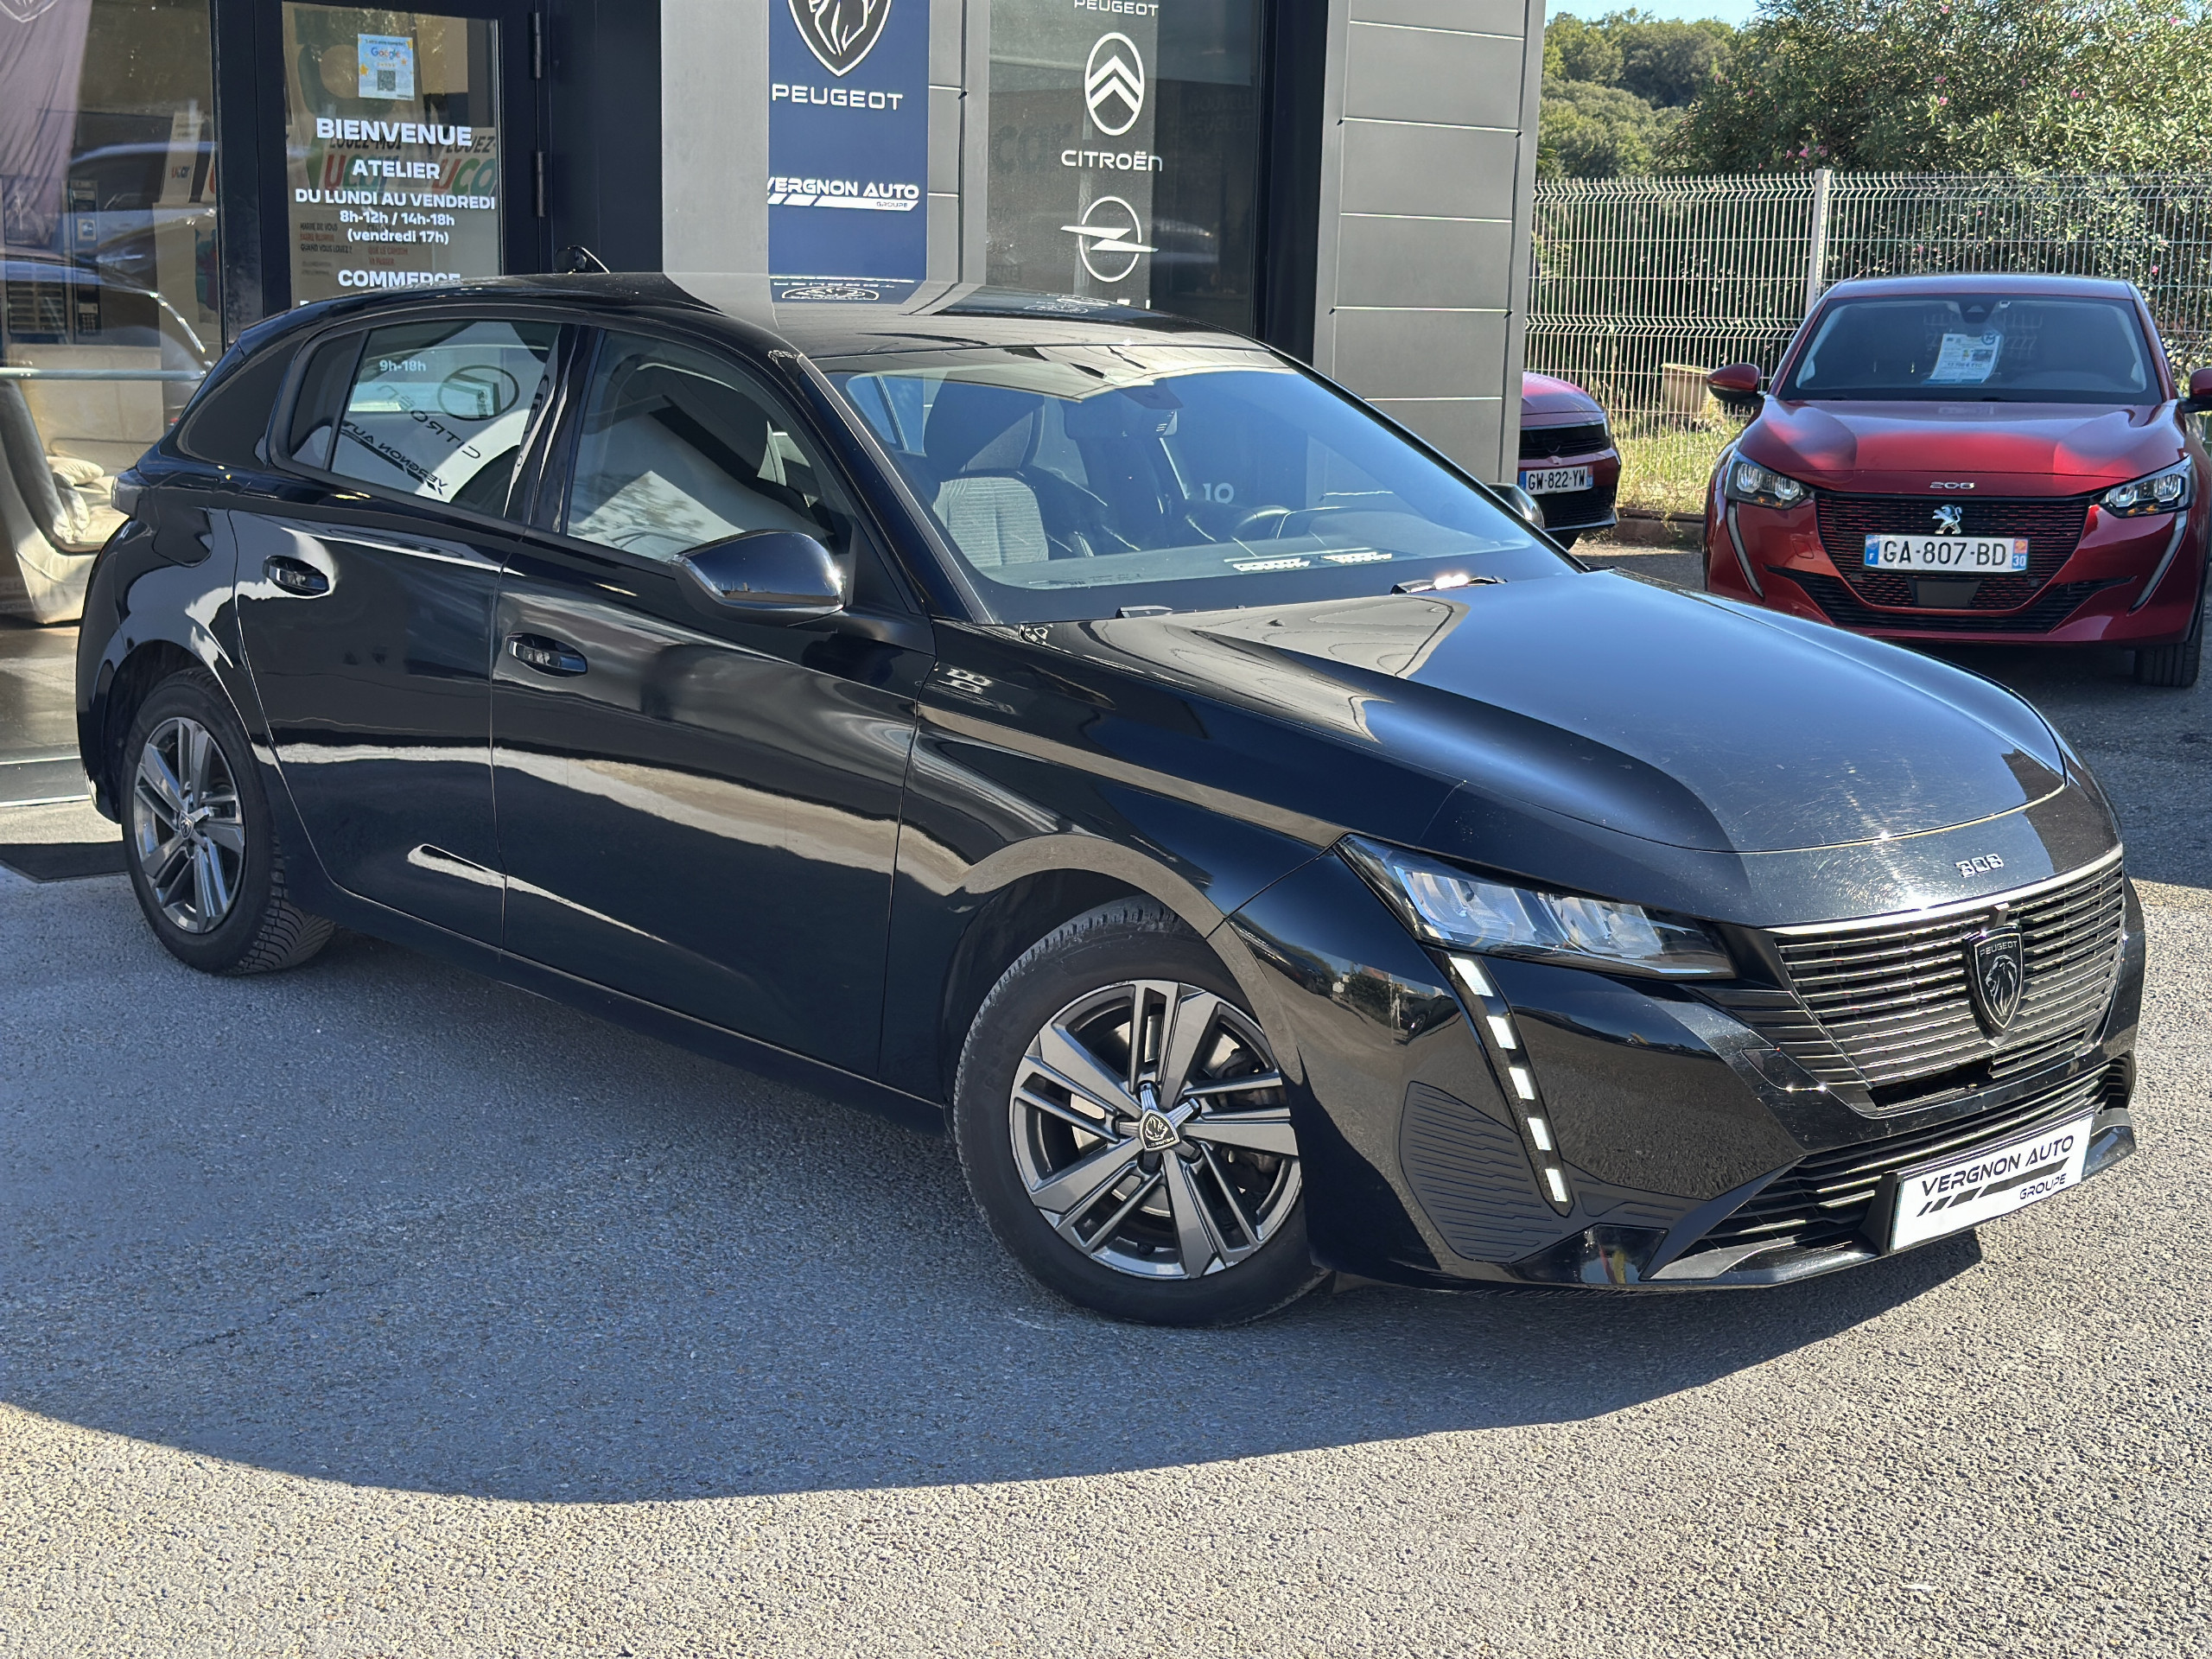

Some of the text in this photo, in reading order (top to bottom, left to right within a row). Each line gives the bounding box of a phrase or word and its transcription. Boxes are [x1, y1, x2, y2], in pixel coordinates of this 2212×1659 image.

[1074, 0, 1159, 16] PEUGEOT
[371, 47, 400, 60] Google
[772, 83, 904, 111] PEUGEOT
[316, 118, 473, 146] BIENVENUE
[353, 159, 441, 180] ATELIER
[296, 188, 495, 210] DU LUNDI AU VENDREDI
[862, 181, 920, 200] AUTO
[340, 210, 389, 224] 8h-12h
[400, 212, 455, 226] 14h-18h
[347, 228, 416, 244] (vendredi
[419, 230, 449, 245] 17h)
[379, 359, 427, 372] 9h-18h
[1529, 469, 1586, 491] GW-822-YW
[1884, 540, 2007, 567] GA-807-BD
[2012, 555, 2027, 567] 30
[1980, 940, 2018, 958] PEUGEOT
[1922, 1135, 2075, 1197] VERGNON AUTO
[2019, 1173, 2068, 1200] GROUPE
